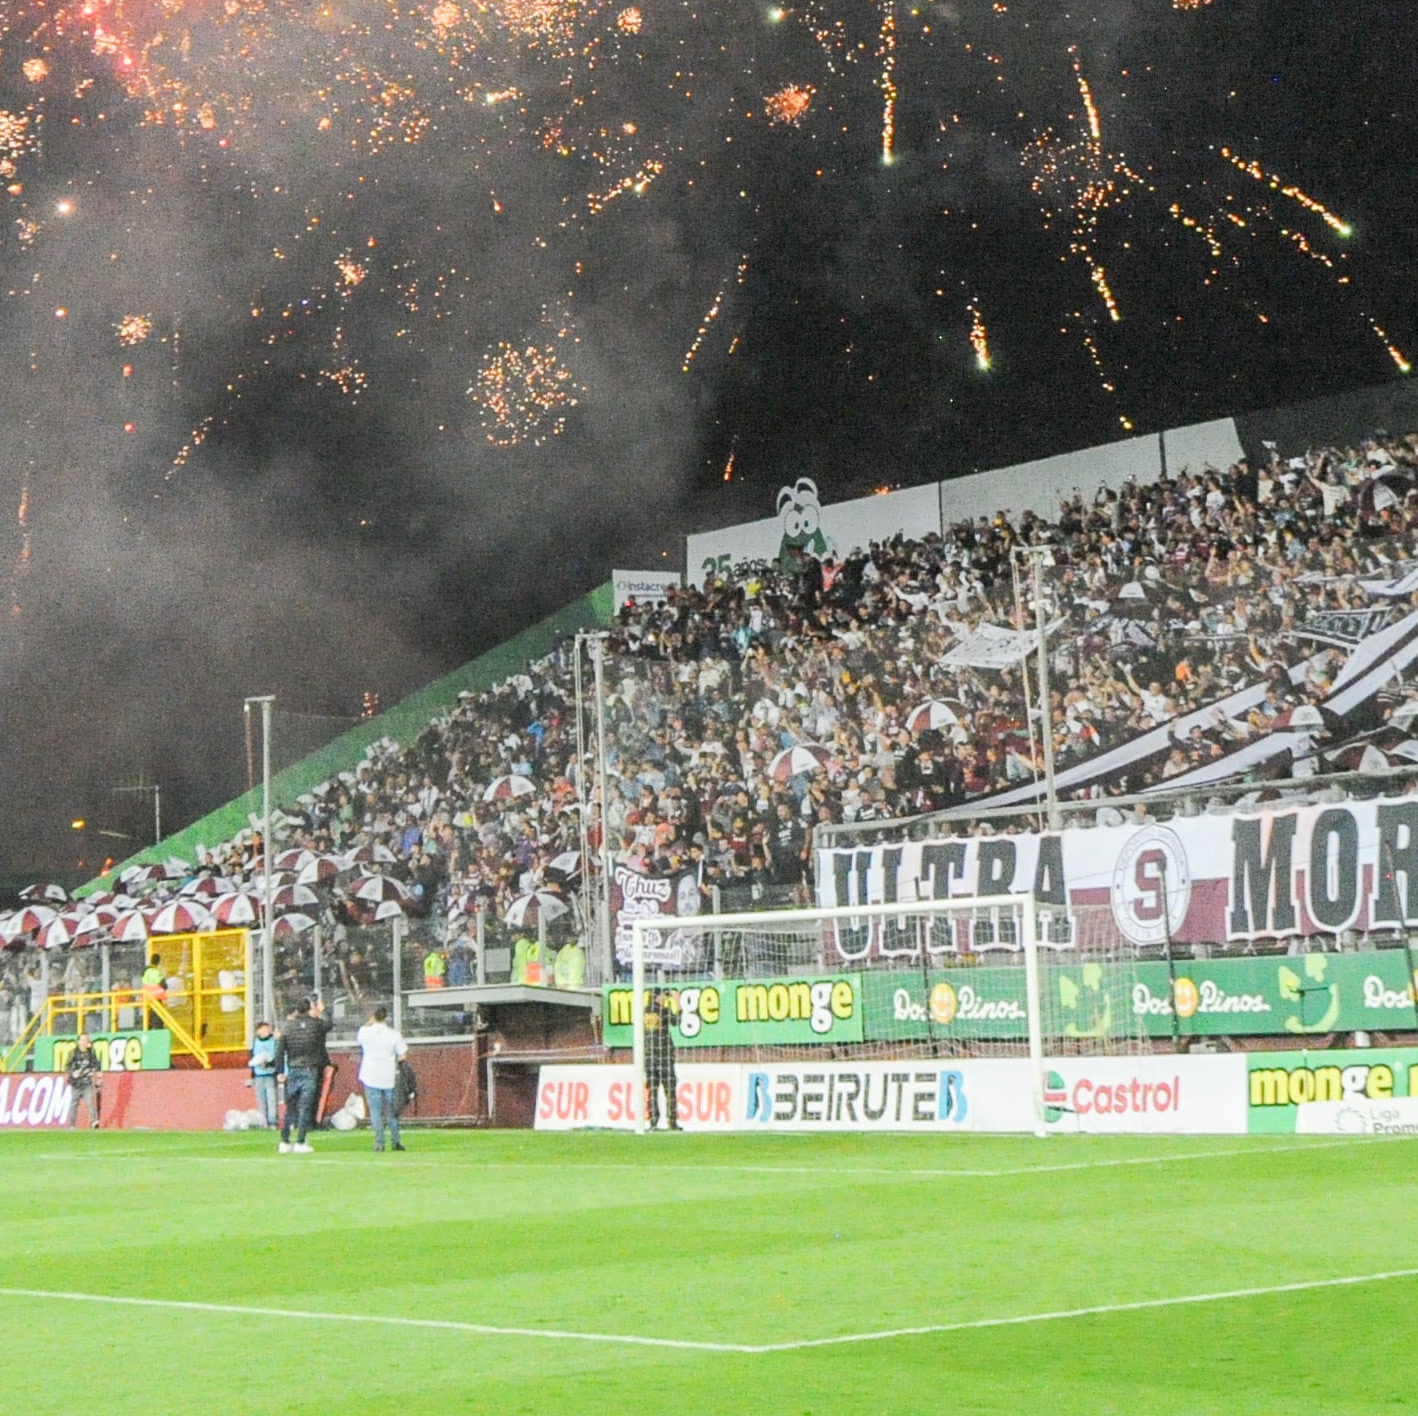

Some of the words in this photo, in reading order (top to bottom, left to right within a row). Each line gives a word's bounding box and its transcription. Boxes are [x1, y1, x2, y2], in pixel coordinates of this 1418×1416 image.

[833, 836, 1075, 959] ULTRA
[609, 986, 719, 1037] mnge
[736, 980, 853, 1034] monge
[958, 985, 1025, 1019] Pinos
[1133, 983, 1173, 1014] Dos
[1198, 980, 1271, 1012] Pinos
[1363, 976, 1412, 1009] Dos
[53, 1036, 142, 1072] mnge
[540, 1082, 588, 1121] SUR
[607, 1082, 650, 1121] SU
[677, 1081, 732, 1122] SUR
[773, 1072, 936, 1122] BEIRUTE
[1073, 1076, 1180, 1114] Castrol
[1250, 1064, 1394, 1106] monge
[1370, 1108, 1400, 1123] Liga
